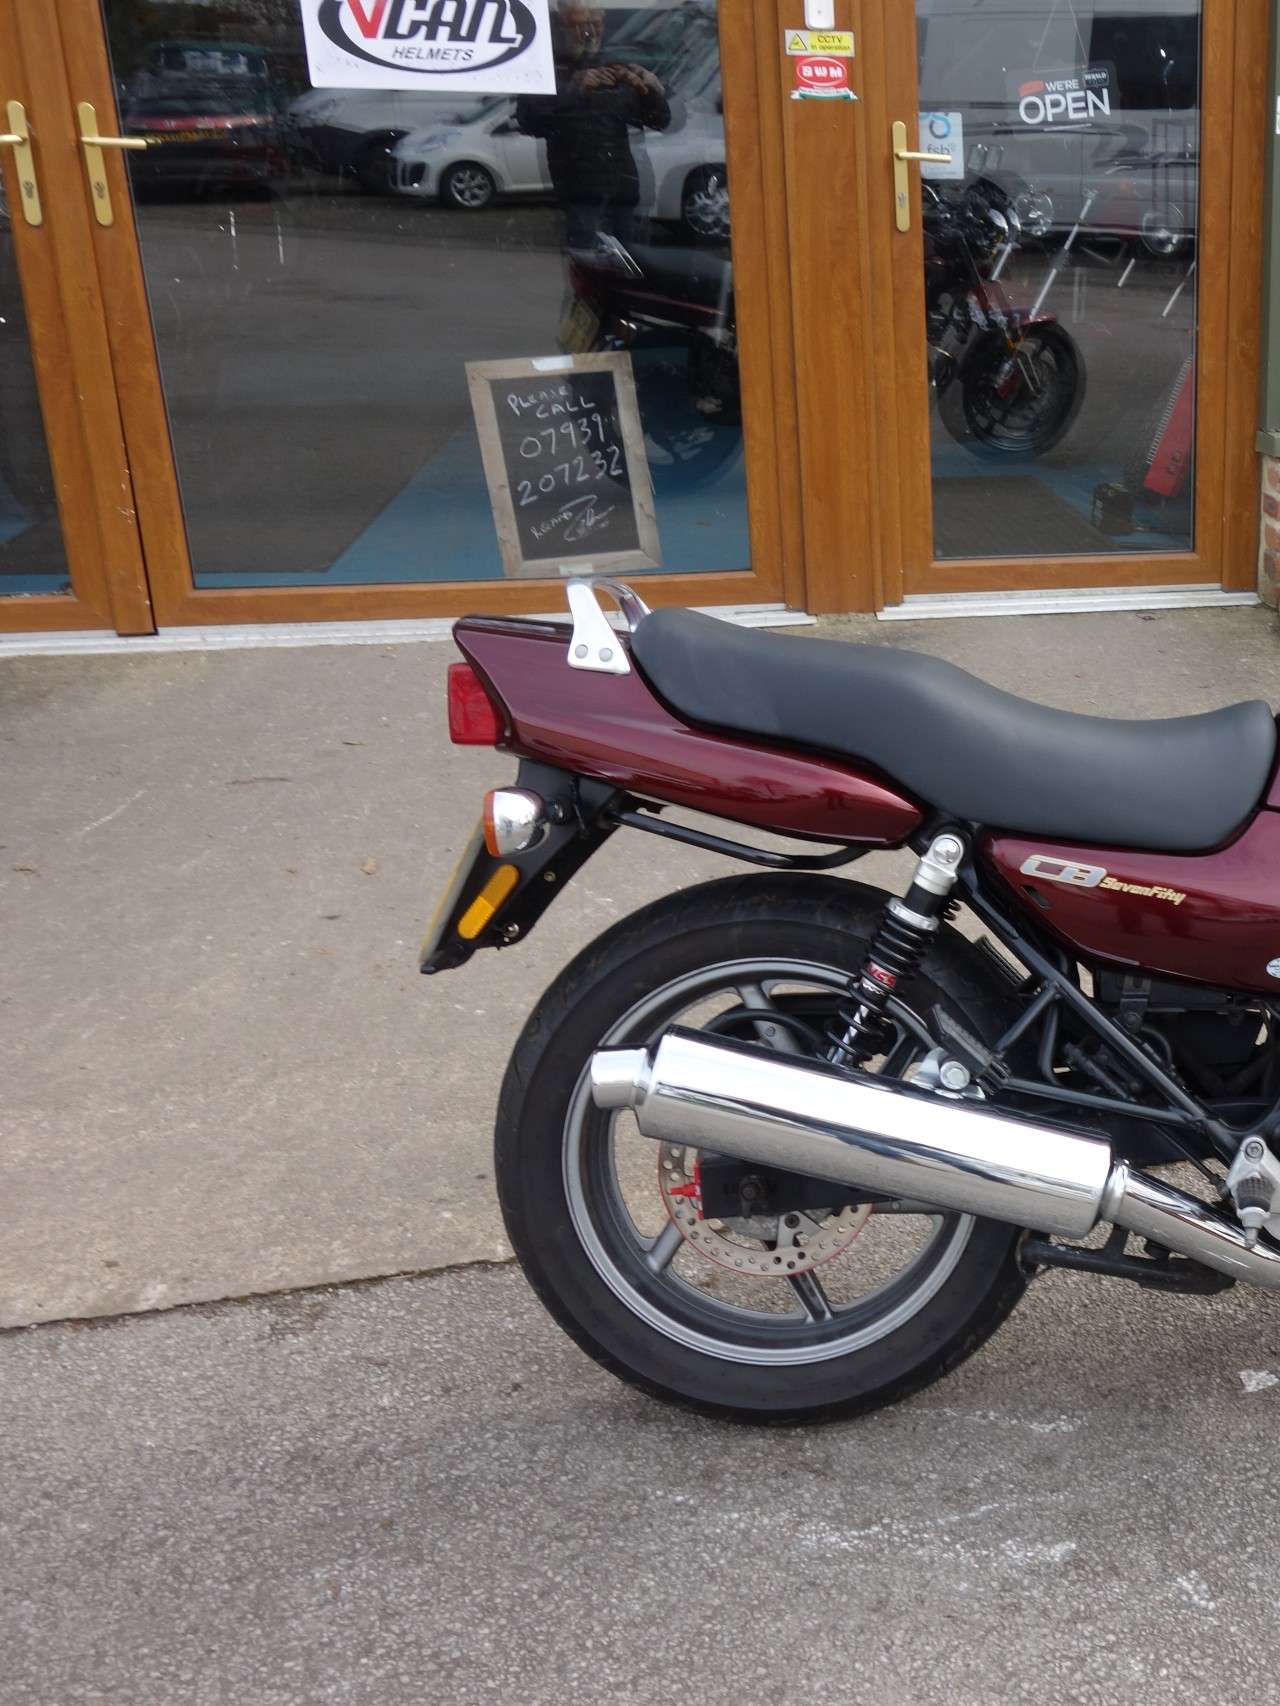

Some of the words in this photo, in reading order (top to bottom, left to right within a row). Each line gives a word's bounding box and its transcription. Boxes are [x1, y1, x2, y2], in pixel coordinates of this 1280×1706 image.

[817, 34, 842, 44] CCTV
[392, 46, 474, 62] HELMETS
[1045, 79, 1080, 92] WE'RE
[1019, 87, 1111, 124] OPEN
[536, 396, 596, 418] CALL
[517, 446, 623, 507] 207232
[1019, 854, 1108, 888] CB
